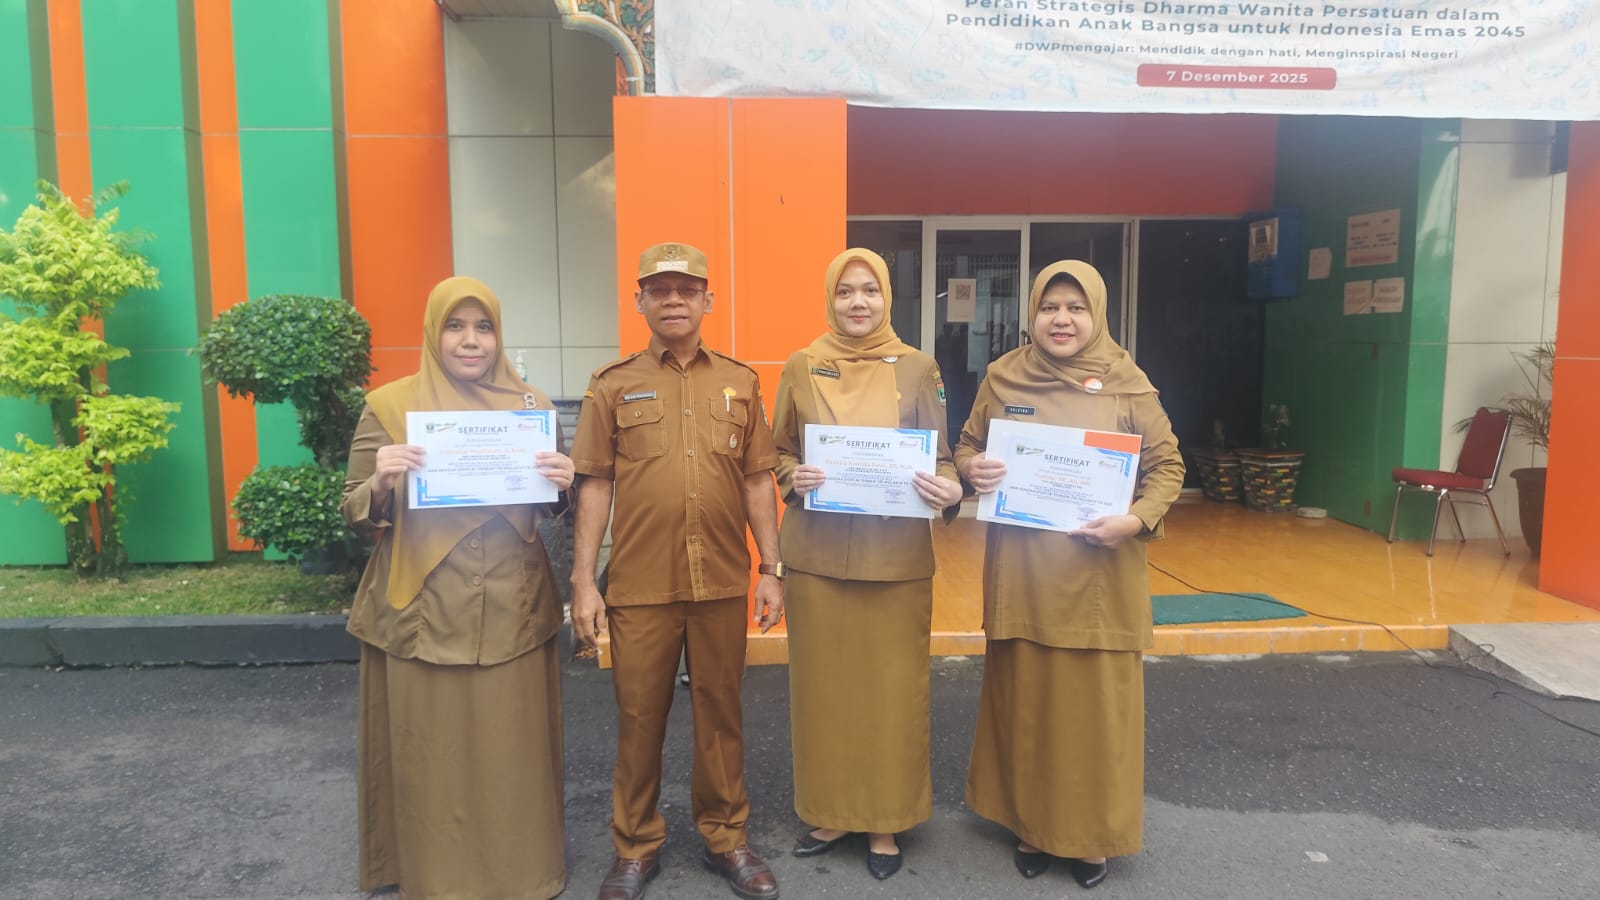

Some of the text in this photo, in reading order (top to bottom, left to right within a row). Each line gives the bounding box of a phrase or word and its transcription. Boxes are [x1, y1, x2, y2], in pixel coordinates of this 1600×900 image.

[965, 0, 1500, 21] Peran Strategis Dharma Wanita Persatuan dalam
[947, 14, 1526, 38] Pendidikan Anak Bangsa untuk Indonesia Emas 2045
[1140, 44, 1205, 55] Mendidik
[1211, 46, 1264, 57] dengan
[1306, 48, 1406, 60] Menginspirasi
[1411, 50, 1458, 60] Negeri
[1166, 71, 1308, 84] 7 Desember 2025
[458, 426, 509, 434] SERTIFIKAT
[846, 440, 891, 449] SERTIFIKAT
[1044, 453, 1090, 467] SERTIFIKAT
